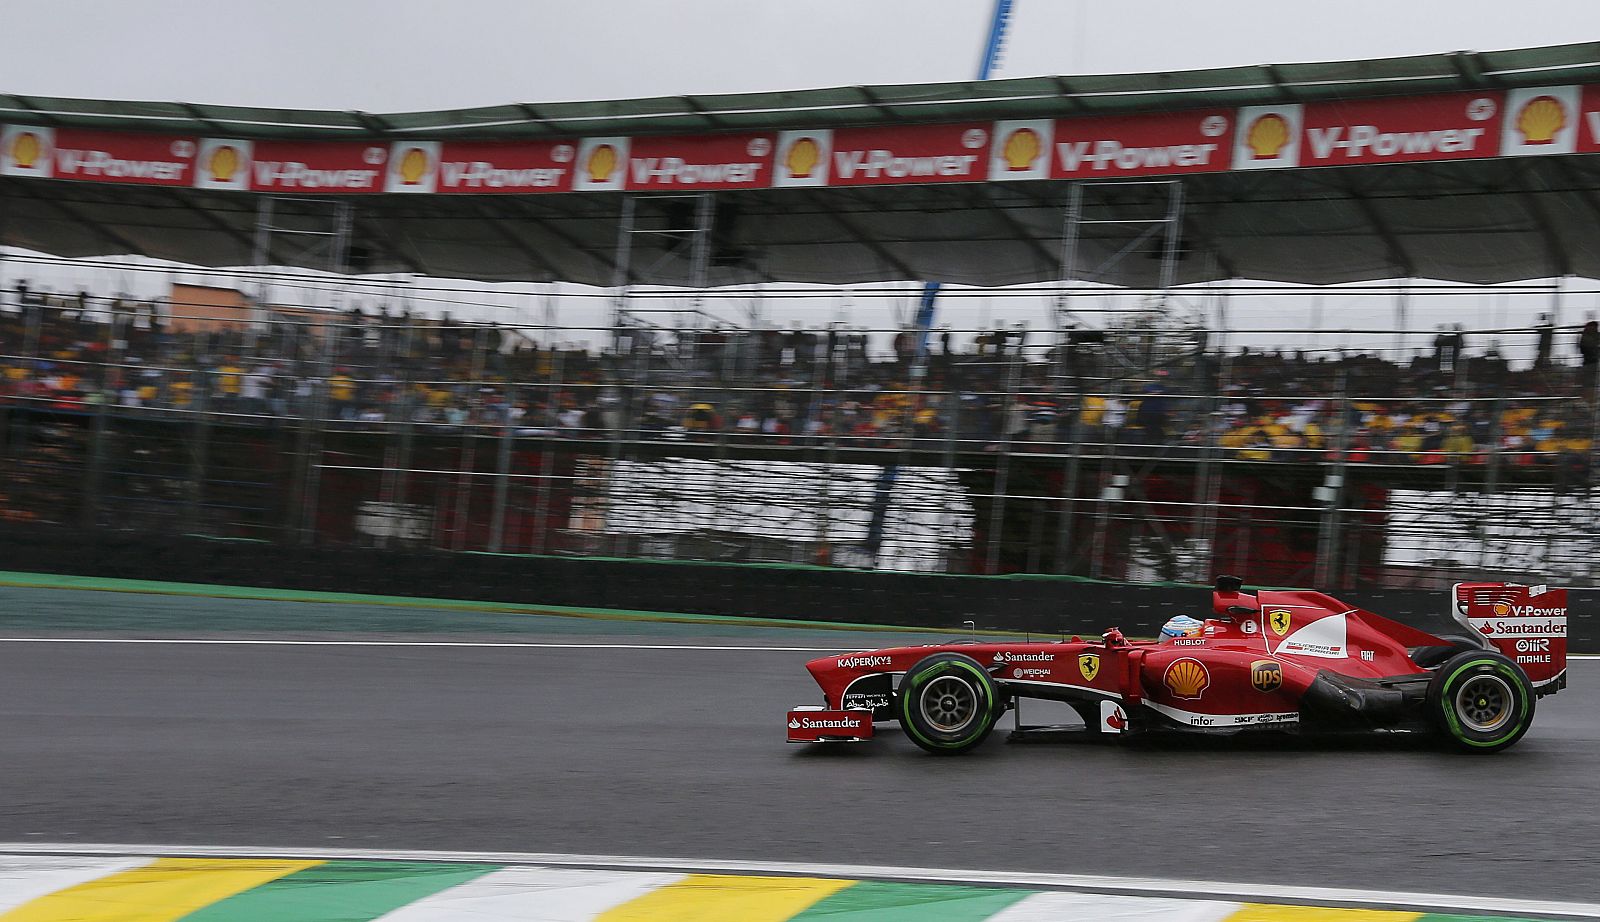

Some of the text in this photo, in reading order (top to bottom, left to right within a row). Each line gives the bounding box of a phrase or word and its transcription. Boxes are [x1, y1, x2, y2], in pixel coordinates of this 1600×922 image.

[1306, 125, 1485, 158] V-Power
[1056, 140, 1217, 171] V-Power
[55, 148, 188, 180] V-Power
[631, 157, 763, 184] V-Power
[834, 150, 978, 179] V-Power
[1511, 605, 1567, 616] V-Power
[1245, 621, 1252, 632] E
[1496, 620, 1567, 634] Santander
[1005, 651, 1055, 662] Santander
[1360, 650, 1375, 662] FIAT
[1516, 655, 1551, 664] MAHLE
[1253, 669, 1281, 688] ups
[802, 716, 861, 729] Santander
[1190, 716, 1214, 726] infor
